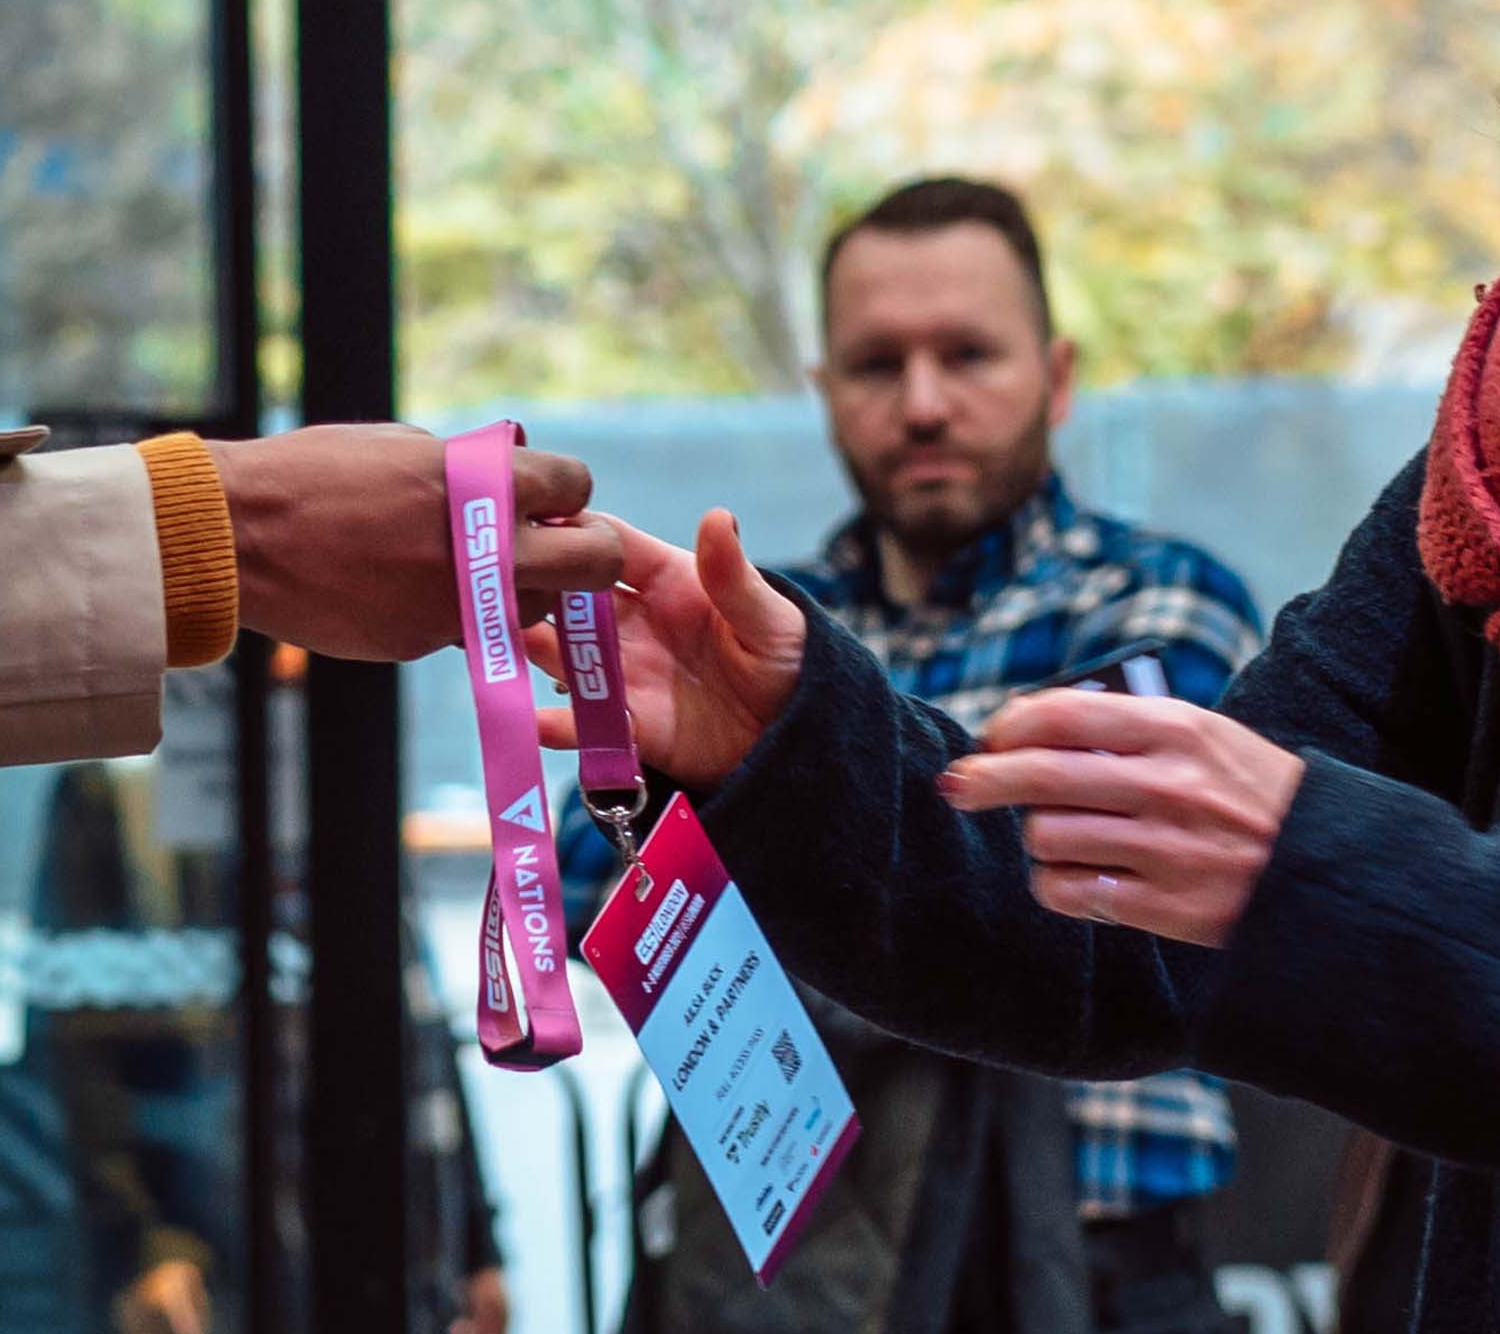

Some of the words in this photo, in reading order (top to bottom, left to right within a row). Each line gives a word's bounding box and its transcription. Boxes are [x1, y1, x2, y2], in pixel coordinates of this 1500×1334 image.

[475, 569, 513, 679] LONDON
[512, 844, 555, 973] NATIONS
[672, 1029, 712, 1092] LONDON
[715, 950, 761, 1022] PARTNERS
